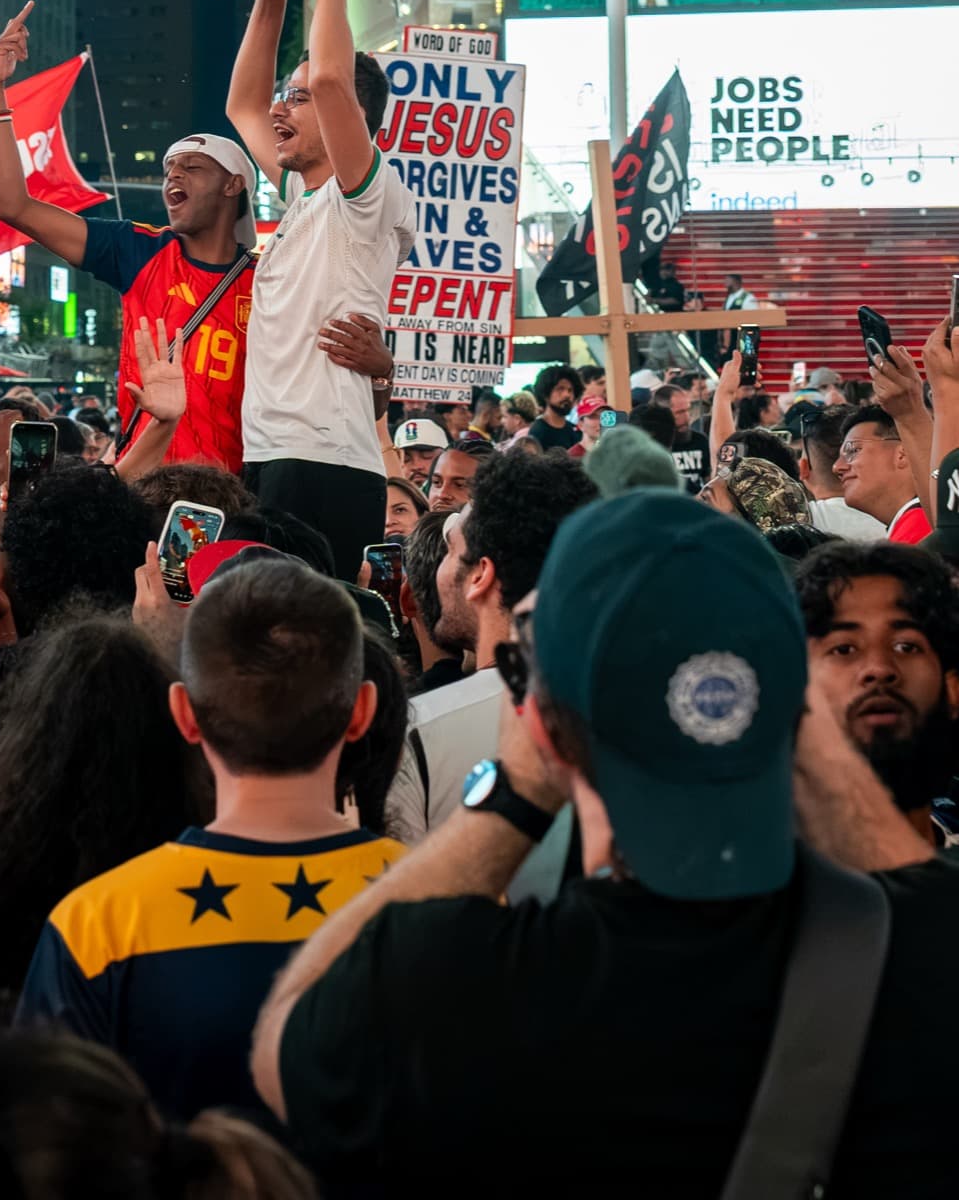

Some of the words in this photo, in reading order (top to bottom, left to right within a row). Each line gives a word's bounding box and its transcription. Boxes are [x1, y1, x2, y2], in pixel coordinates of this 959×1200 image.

[413, 33, 444, 52] WORD
[448, 36, 463, 52] OF
[469, 38, 492, 55] GOD
[385, 59, 517, 104] ONLY
[710, 75, 804, 104] JOBS
[376, 99, 515, 161] JESUS
[710, 107, 802, 134] NEED
[711, 135, 851, 163] PEOPLE
[710, 191, 799, 210] indeed
[464, 206, 490, 238] &
[387, 274, 513, 322] EPENT
[397, 317, 433, 330] AWAY
[437, 321, 475, 333] FROM
[480, 323, 503, 335] SIN
[194, 324, 238, 381] 19
[414, 330, 437, 362] IS
[452, 334, 507, 367] NEAR
[421, 366, 444, 383] DAY
[447, 367, 458, 383] IS
[460, 368, 505, 386] COMING
[457, 390, 472, 402] 24
